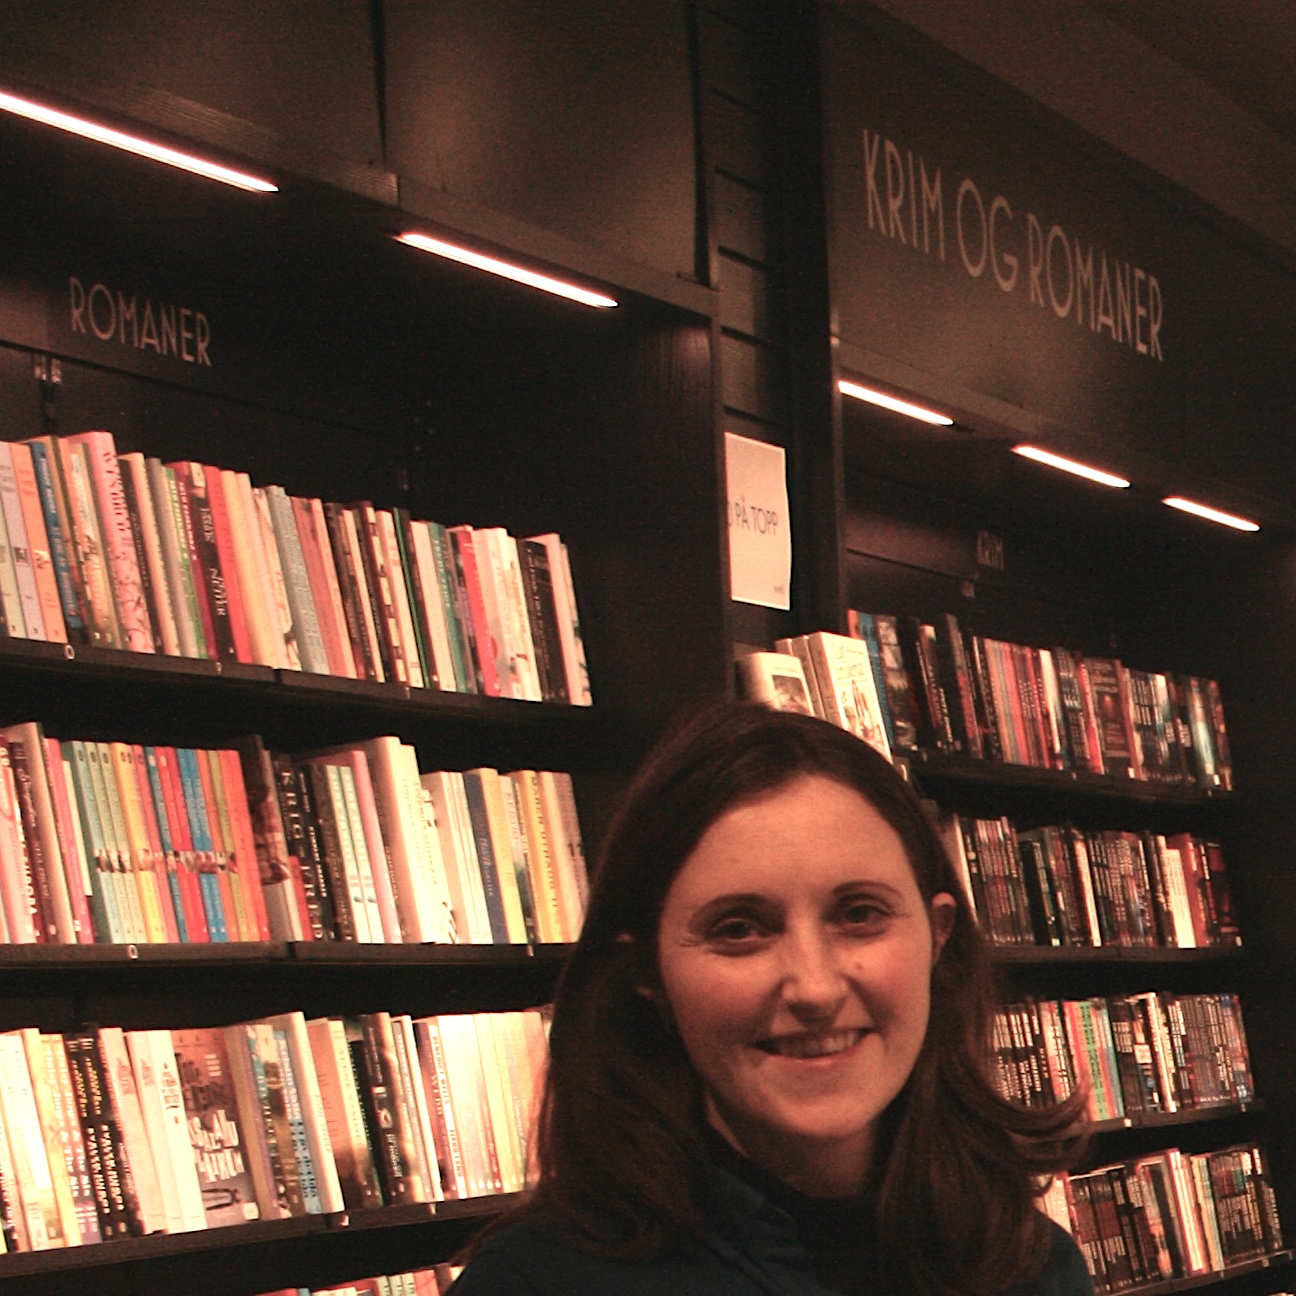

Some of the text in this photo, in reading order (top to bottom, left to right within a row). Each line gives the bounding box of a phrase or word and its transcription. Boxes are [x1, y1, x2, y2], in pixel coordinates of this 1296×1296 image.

[68, 277, 212, 367] ROMANER
[862, 129, 1165, 362] KRIM OG ROMANER
